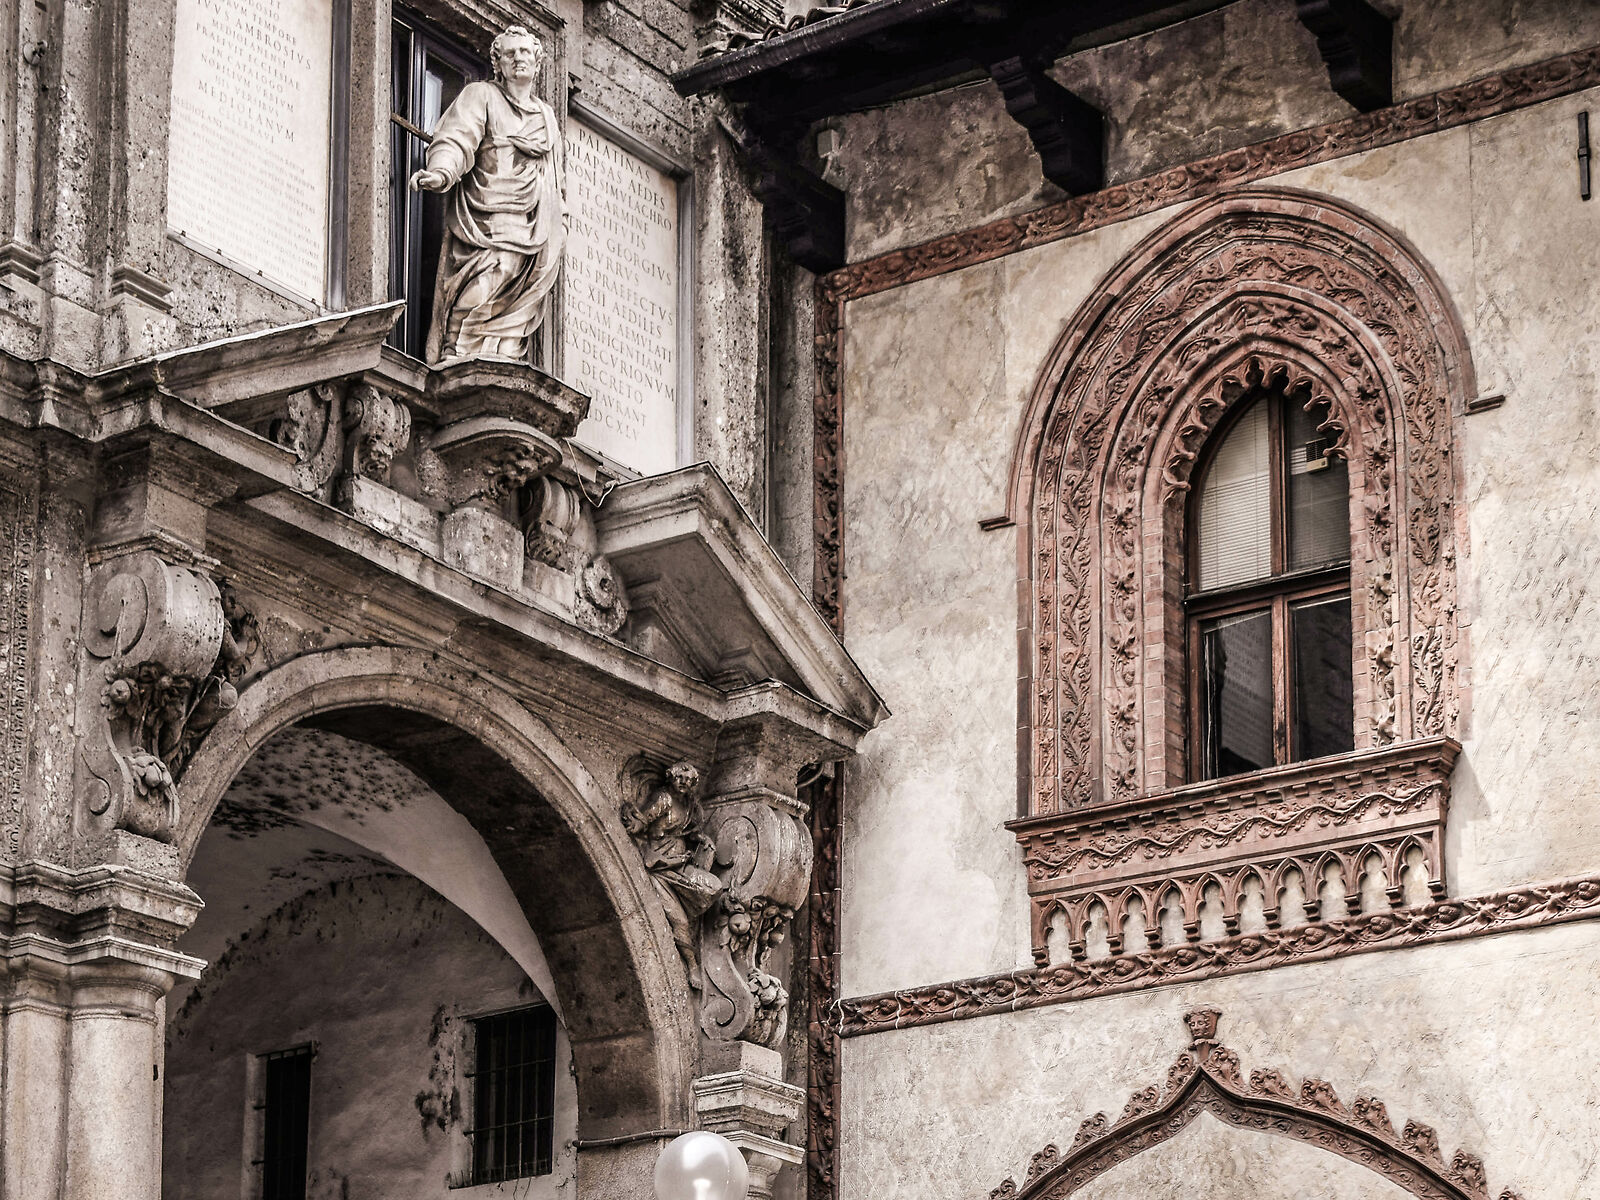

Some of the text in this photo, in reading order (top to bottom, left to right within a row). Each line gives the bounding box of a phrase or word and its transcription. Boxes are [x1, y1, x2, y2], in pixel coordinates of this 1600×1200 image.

[212, 19, 286, 69] MEDIOLANENSI
[236, 18, 312, 71] AMBROSIVS
[253, 14, 297, 46] TEMPORE
[196, 22, 301, 91] PRAEFVIT ECCLESIAE
[201, 53, 294, 112] NOBILIVM VRBIVM
[212, 46, 283, 93] IN CATALOGO
[198, 80, 294, 143] MEDIOLANVM
[565, 139, 665, 211] DILAPSAS AEDES
[579, 128, 651, 183] PALATINAS
[578, 184, 649, 236] ET CARMINE
[581, 203, 646, 250] RESTITVTIS
[600, 179, 672, 231] SIMVLACHRO
[587, 246, 640, 286] BVRRVS
[606, 238, 672, 286] GEORGIVS
[588, 285, 605, 307] XII
[612, 302, 662, 339] AEDILES
[595, 270, 673, 326] PRAEFECTVS
[616, 324, 671, 363] AEMVLATI
[581, 360, 643, 405] DECRETO
[582, 339, 674, 402] DECVRIONVM
[575, 378, 647, 427] INSTAVRANT
[589, 407, 640, 441] DCXLV
